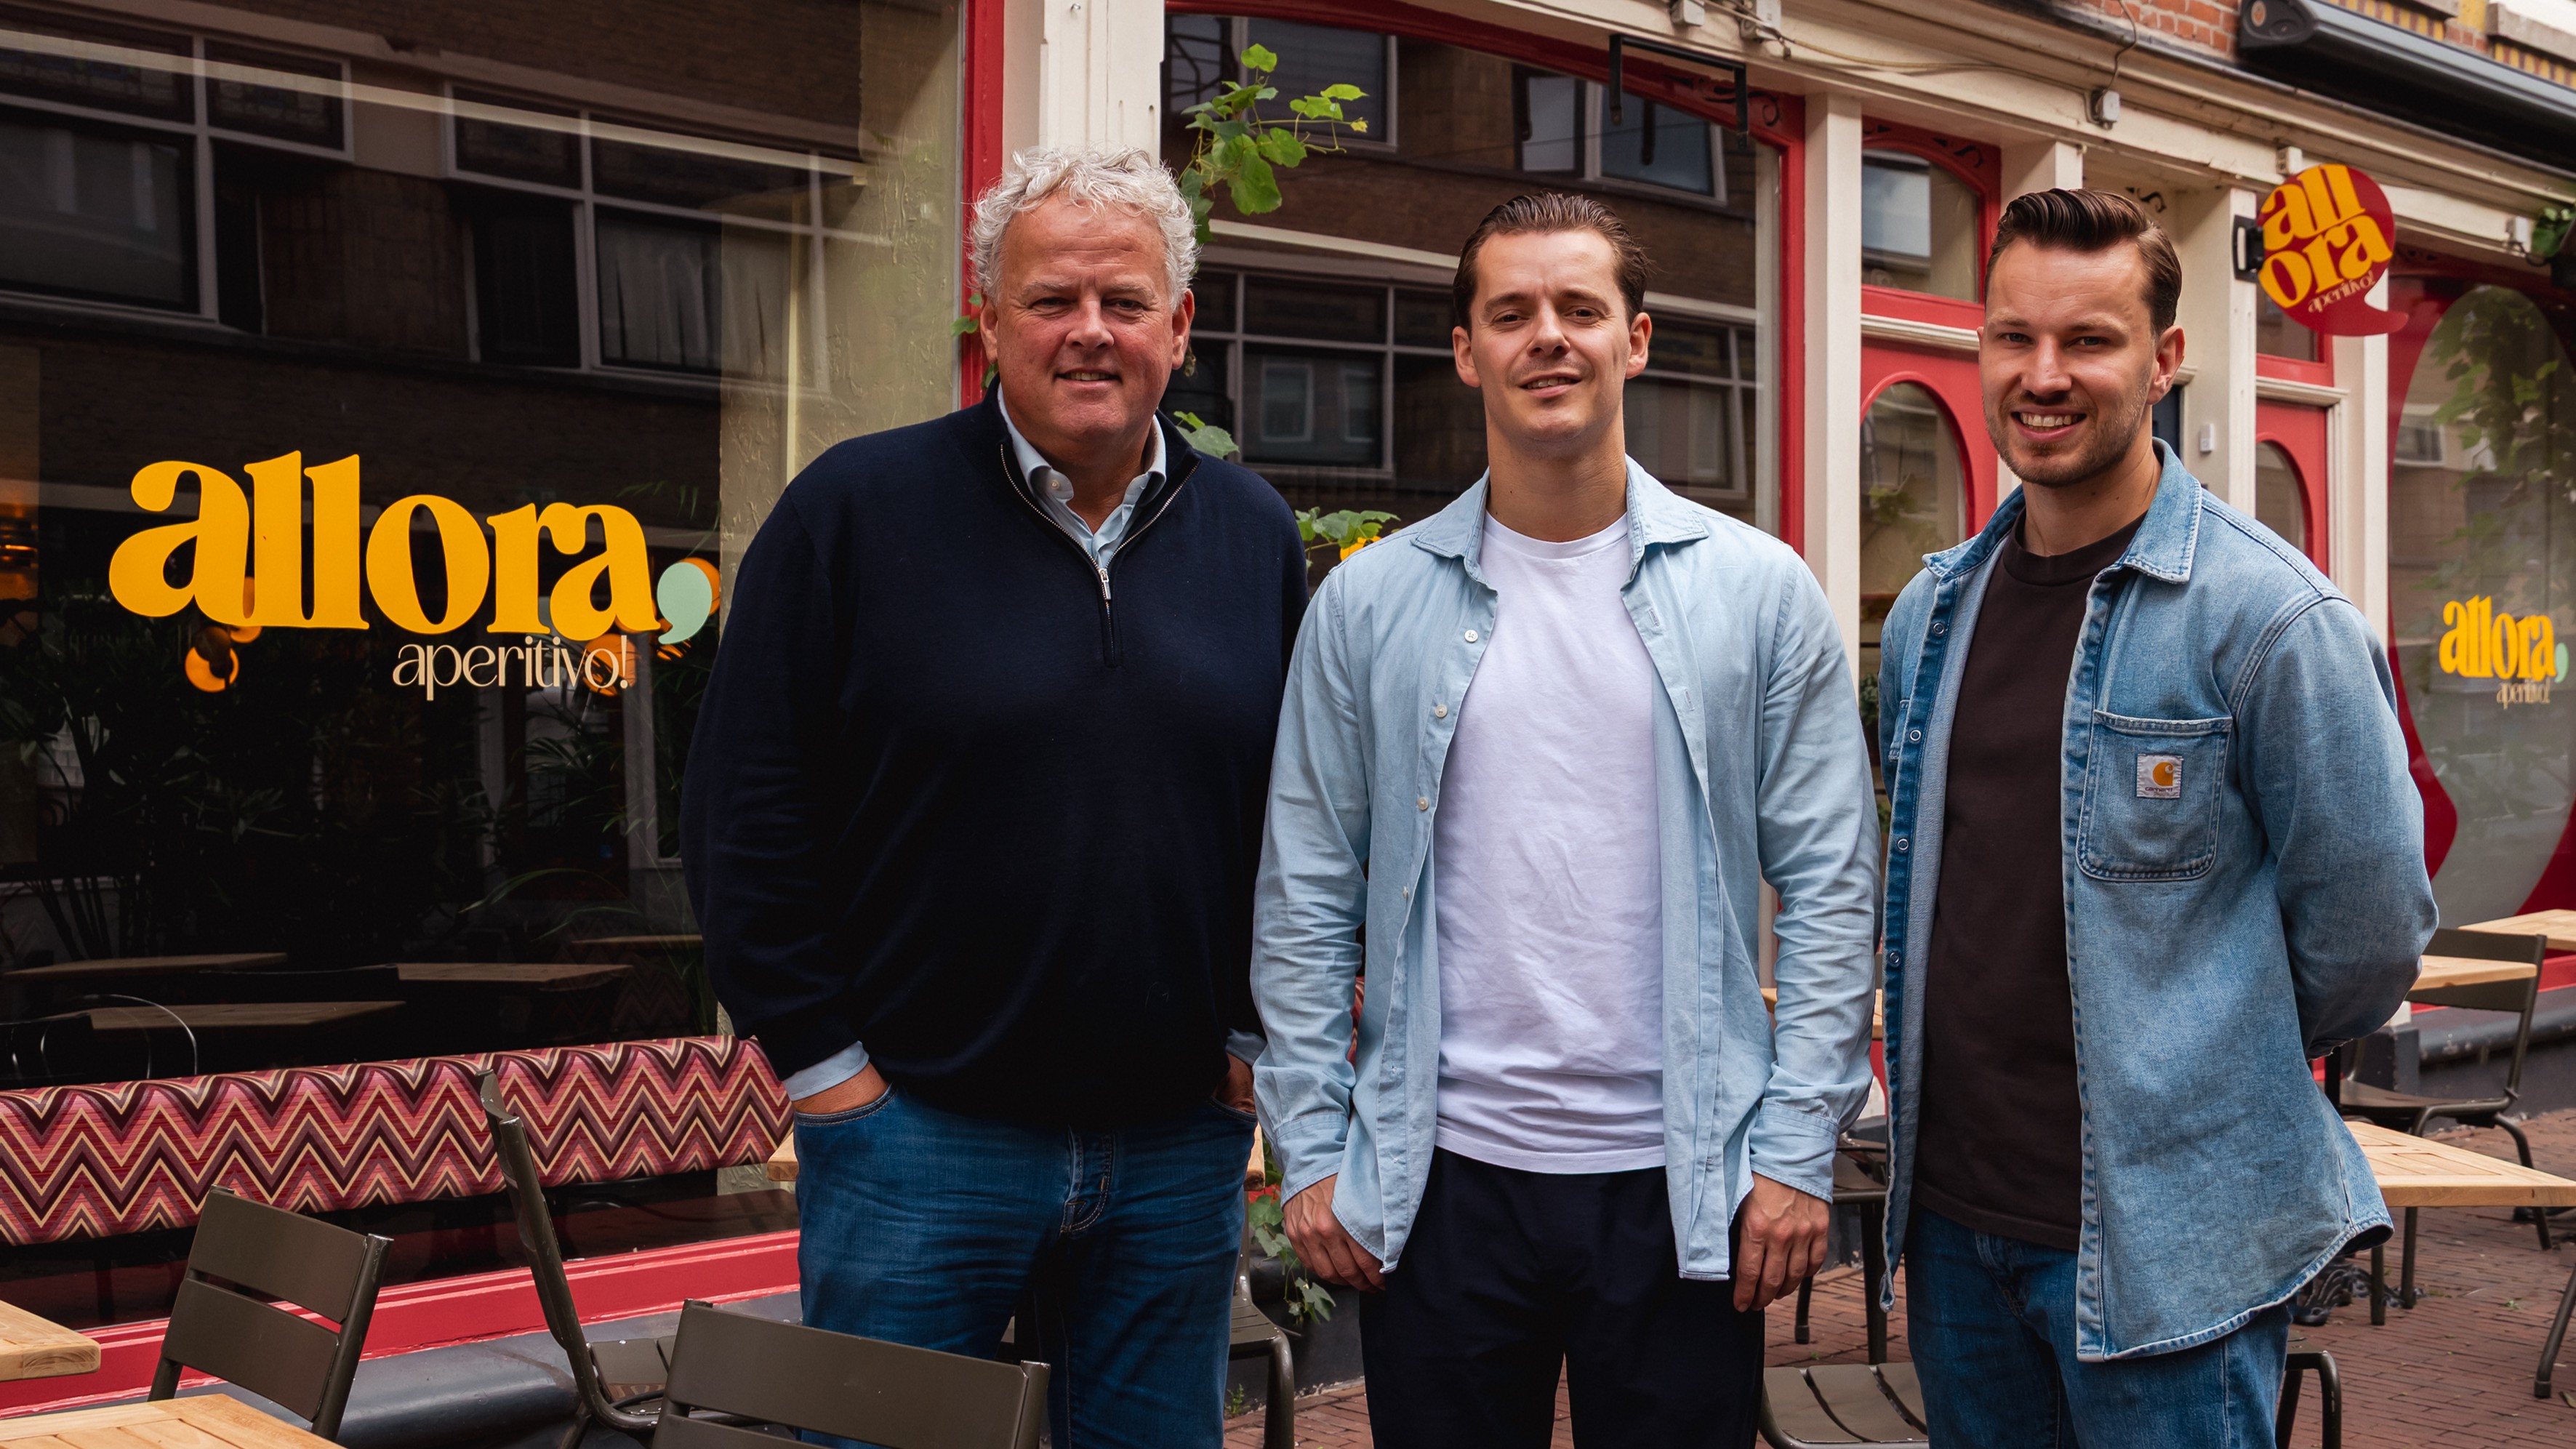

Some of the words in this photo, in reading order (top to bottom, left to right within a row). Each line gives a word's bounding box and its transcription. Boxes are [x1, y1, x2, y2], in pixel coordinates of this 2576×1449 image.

[2260, 164, 2365, 250] all
[2258, 215, 2393, 308] ora
[393, 635, 628, 701] aperitivo!
